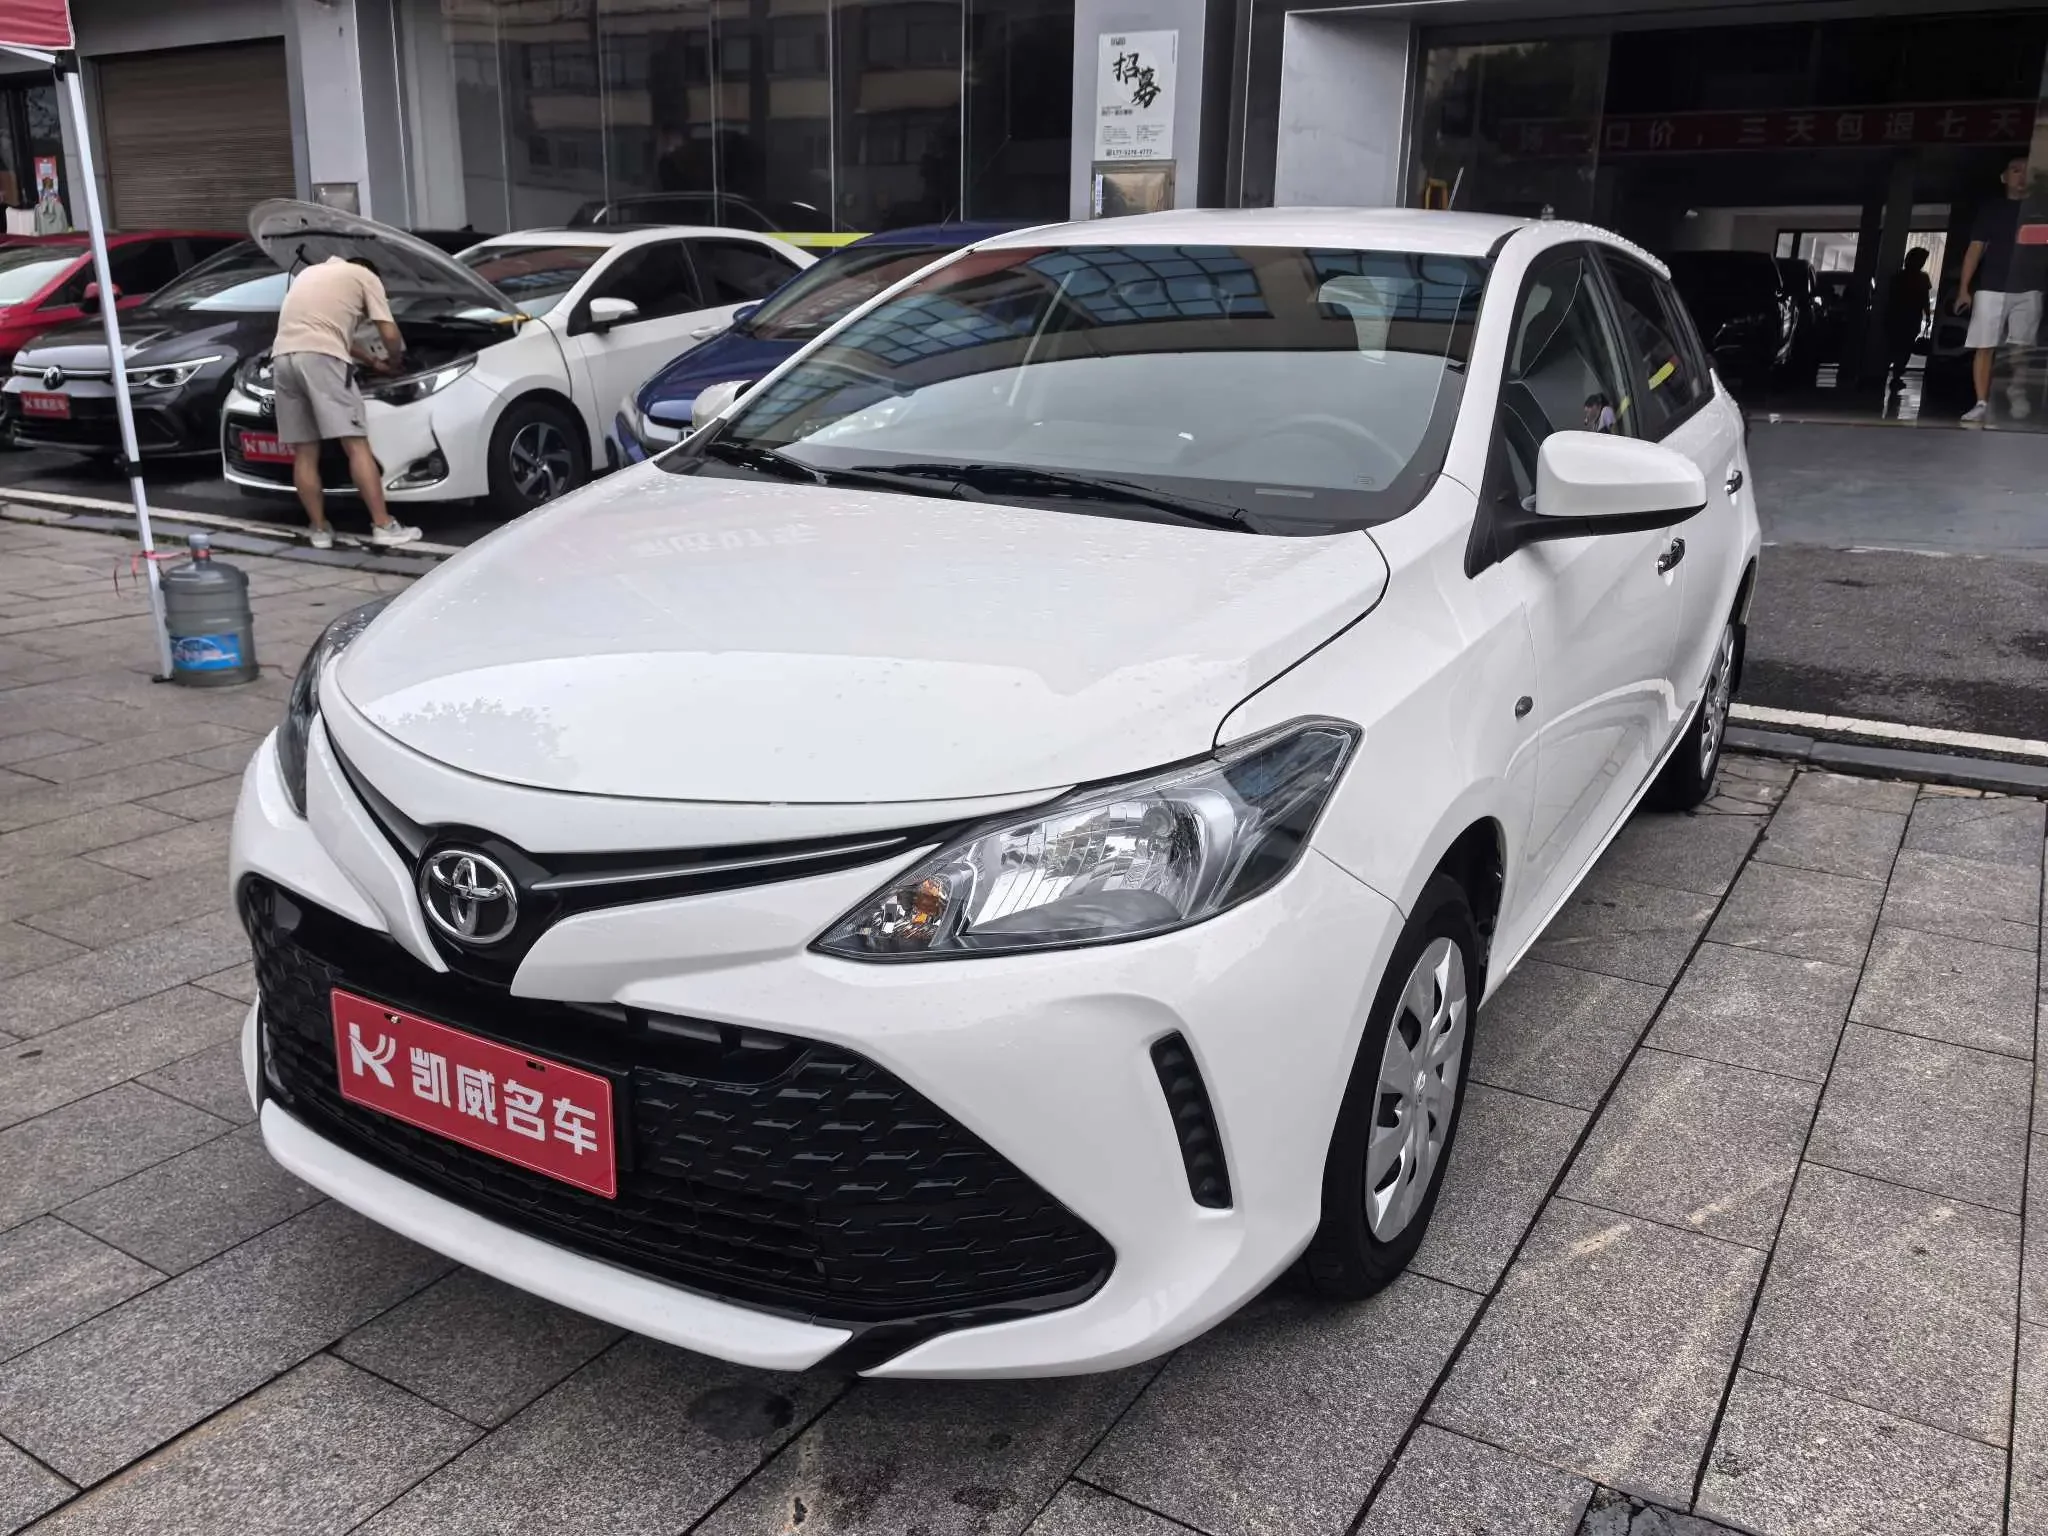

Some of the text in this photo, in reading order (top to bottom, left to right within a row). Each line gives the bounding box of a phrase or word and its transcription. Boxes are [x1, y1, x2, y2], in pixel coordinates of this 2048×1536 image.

[1112, 51, 1162, 109] 招募
[409, 1046, 598, 1155] 凯威名车
